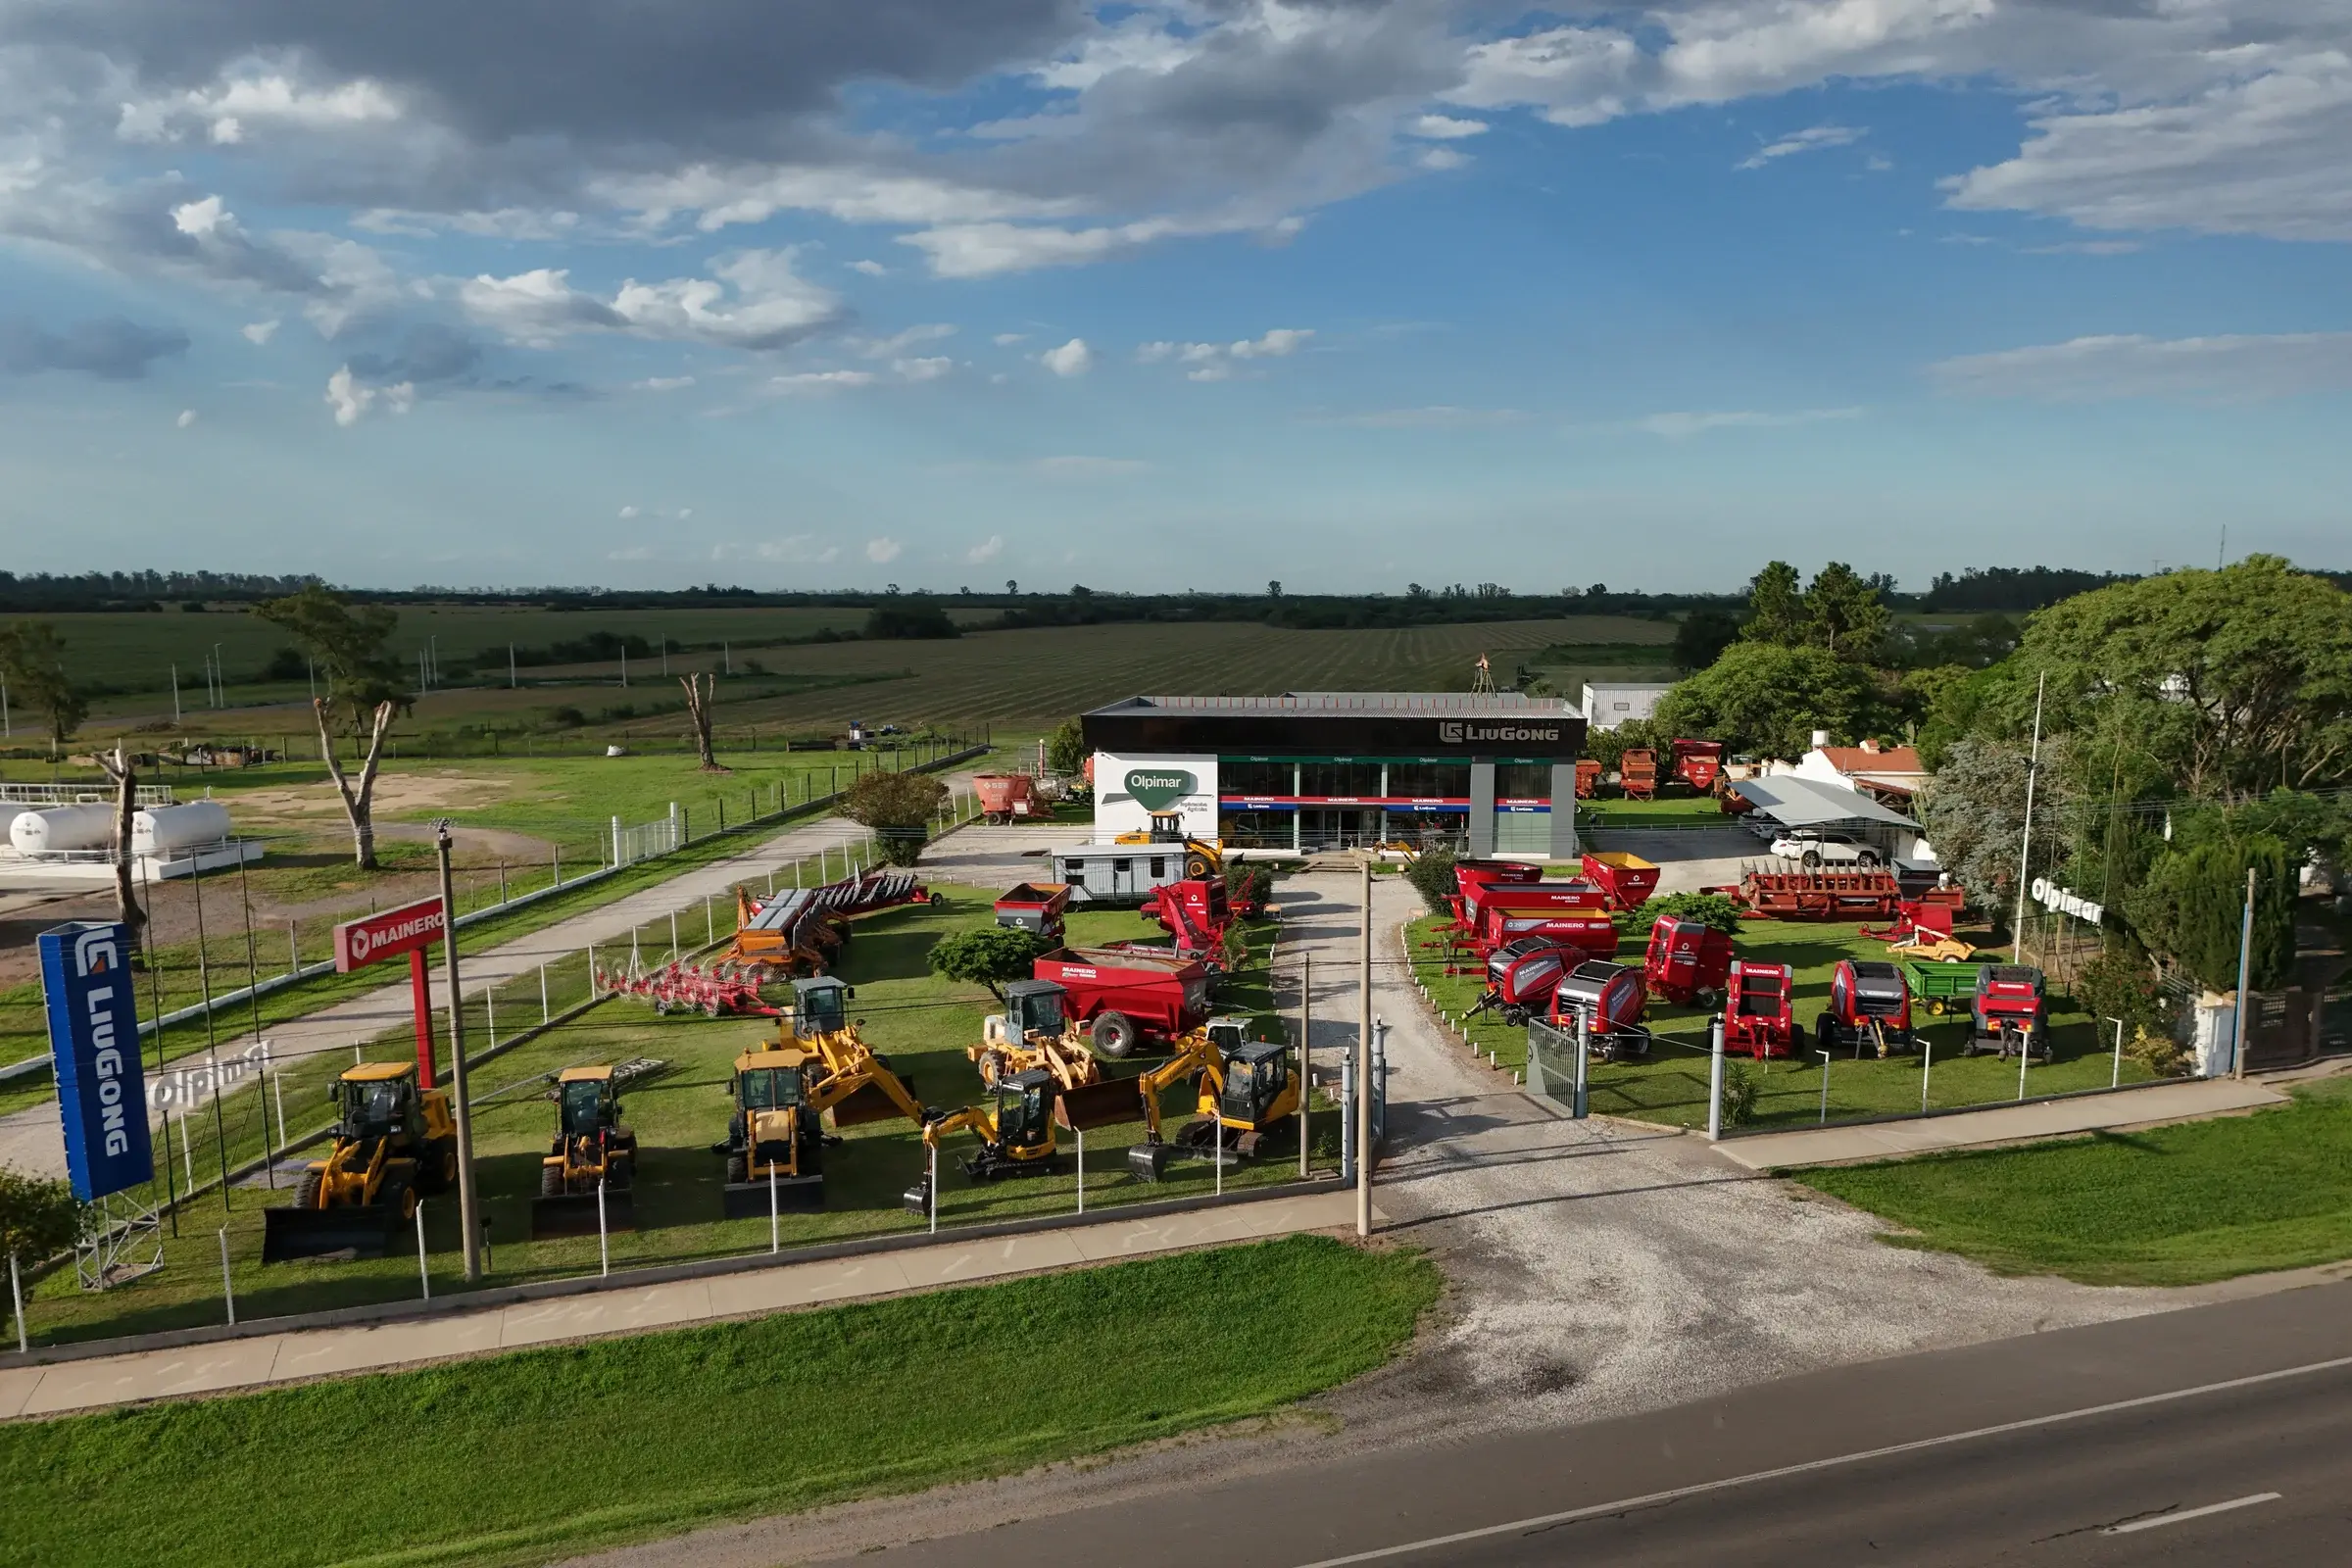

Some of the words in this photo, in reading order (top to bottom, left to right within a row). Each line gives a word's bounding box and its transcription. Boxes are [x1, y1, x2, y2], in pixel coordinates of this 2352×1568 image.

[1131, 775, 1181, 790] Olpimar
[2032, 877, 2105, 924] Olpimar
[371, 911, 445, 949] MAINERO
[1062, 966, 1097, 975] MAINERO
[1518, 959, 1548, 976] MAINERO
[86, 985, 129, 1158] LIUGONG
[148, 1039, 274, 1110] Olpimar
